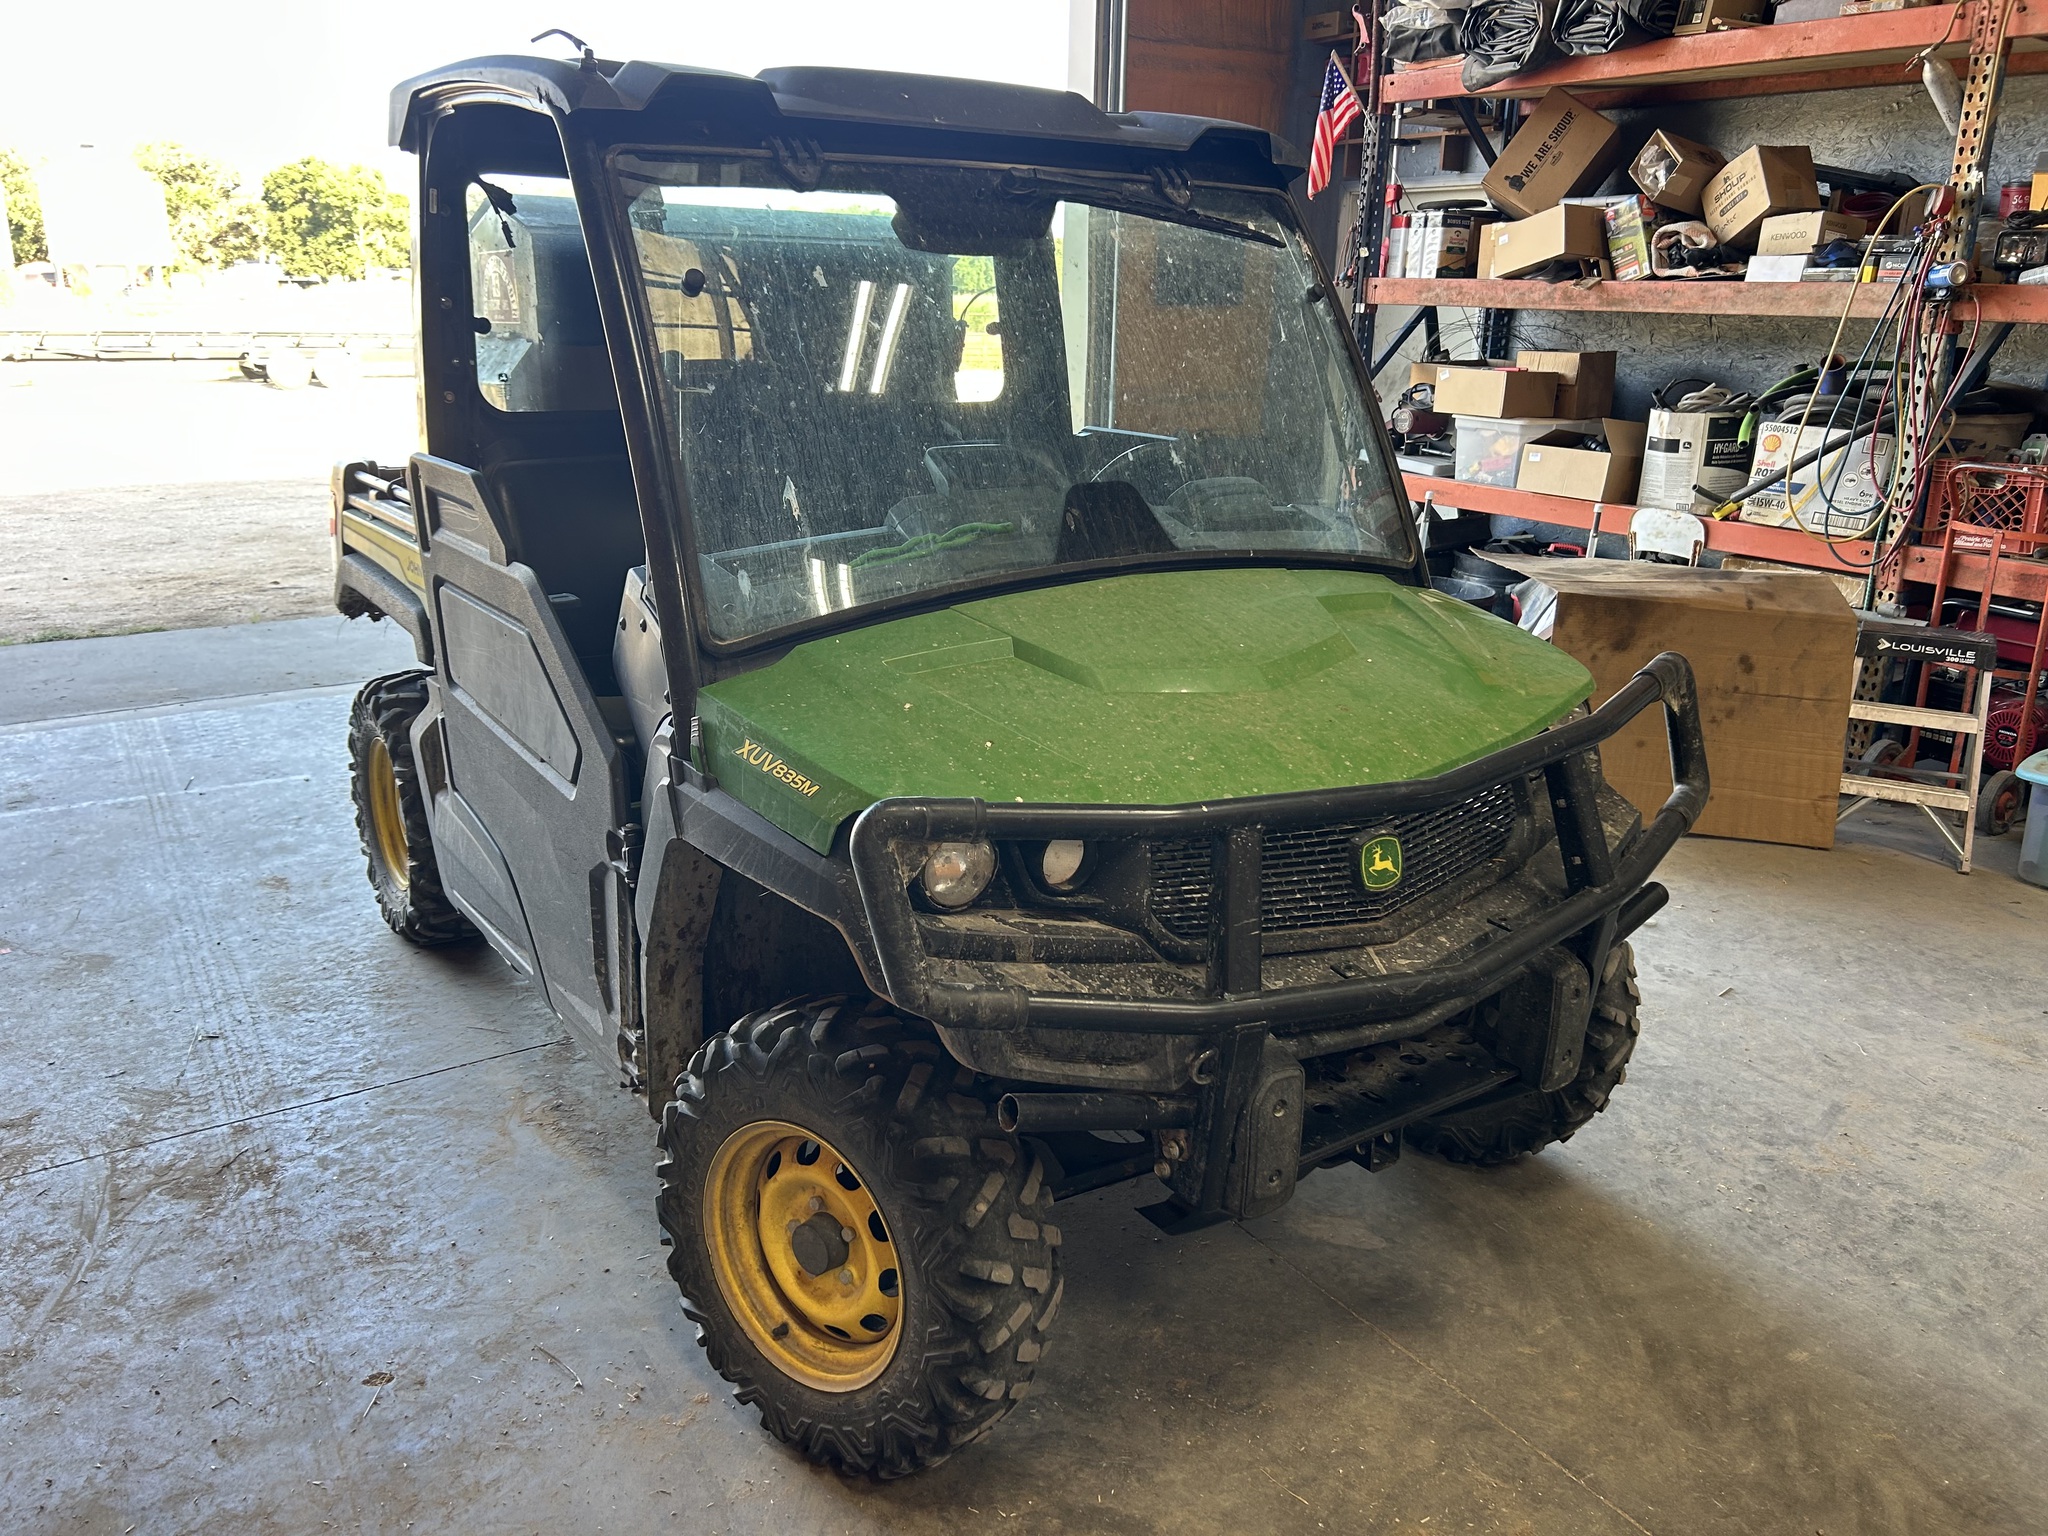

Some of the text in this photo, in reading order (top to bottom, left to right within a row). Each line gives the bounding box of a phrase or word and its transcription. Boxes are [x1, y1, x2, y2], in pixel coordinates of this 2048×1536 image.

[1521, 160, 1538, 179] WE
[1534, 141, 1553, 163] ARE
[1714, 171, 1747, 204] SHOUP
[1770, 230, 1808, 241] KENWOOD
[1764, 424, 1799, 435] 55004512
[1756, 460, 1776, 468] Shell
[1859, 489, 1874, 499] 6PK
[1755, 497, 1786, 510] 15W-40
[1892, 641, 1976, 658] LOUISVILLE
[1997, 734, 2016, 742] GX
[1998, 729, 2018, 737] HONDA
[735, 738, 820, 798] XUV835M
